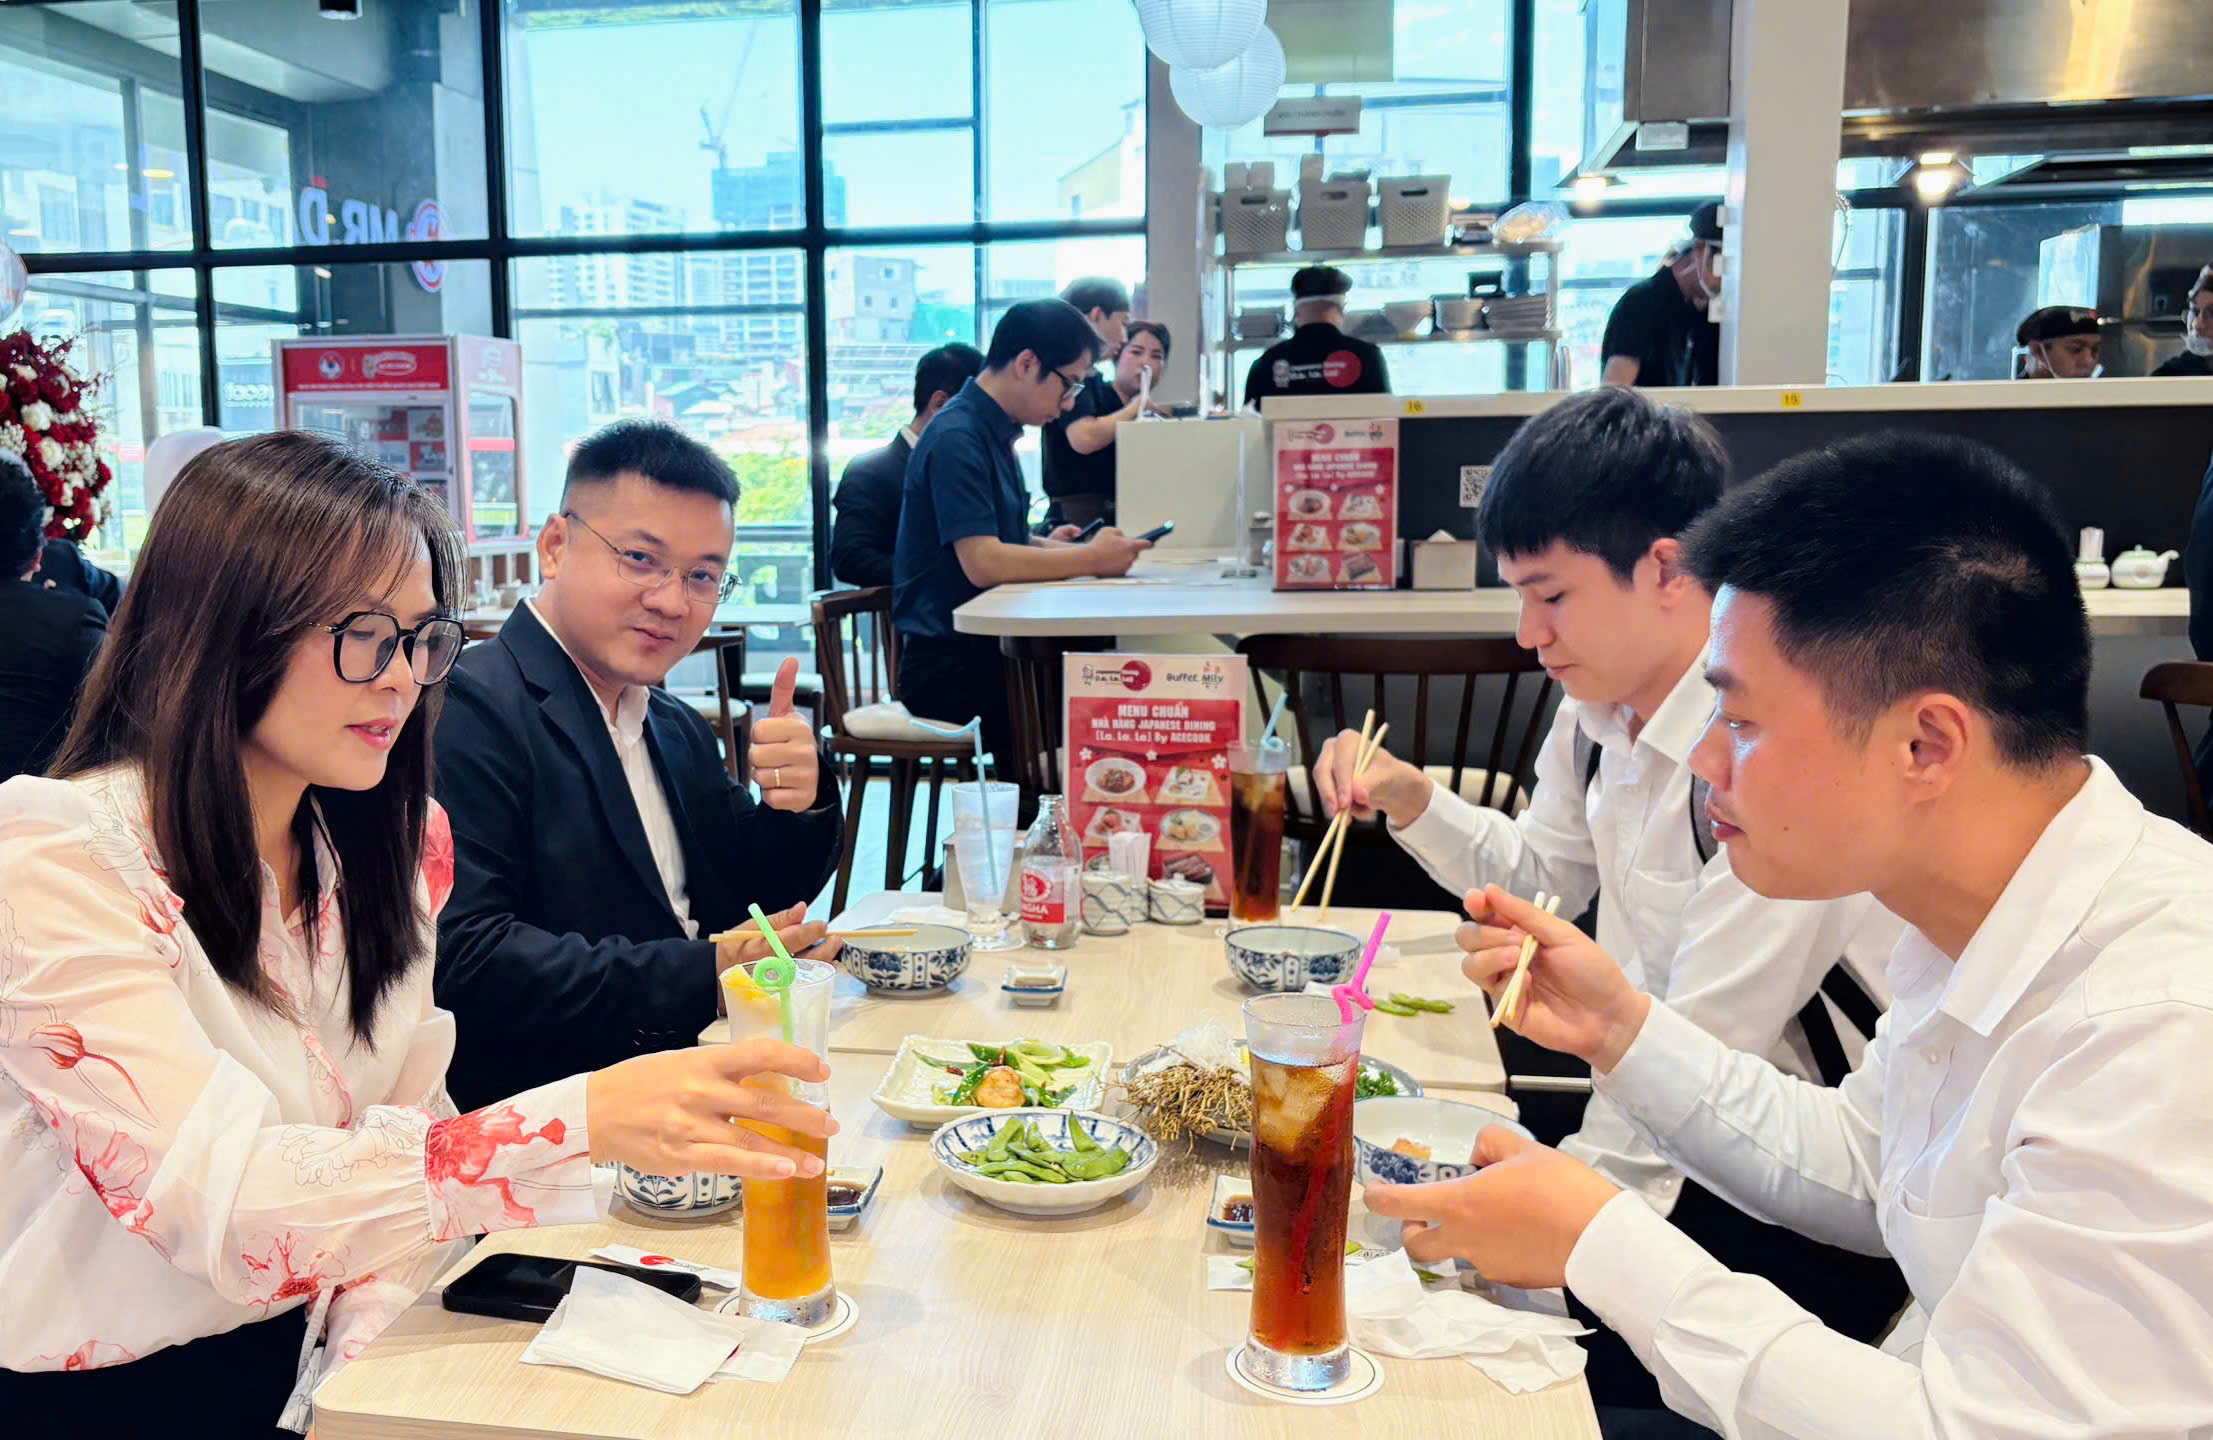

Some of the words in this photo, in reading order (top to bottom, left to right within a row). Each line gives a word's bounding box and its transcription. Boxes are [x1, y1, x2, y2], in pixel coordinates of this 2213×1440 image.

[1166, 673, 1198, 682] Buffet
[1118, 704, 1149, 717] MENU
[1091, 715, 1109, 729] NHÀ
[1138, 719, 1181, 731] JAPANESE
[1184, 720, 1216, 731] DINING
[1154, 731, 1169, 744] By
[1170, 733, 1212, 744] ACECOOK
